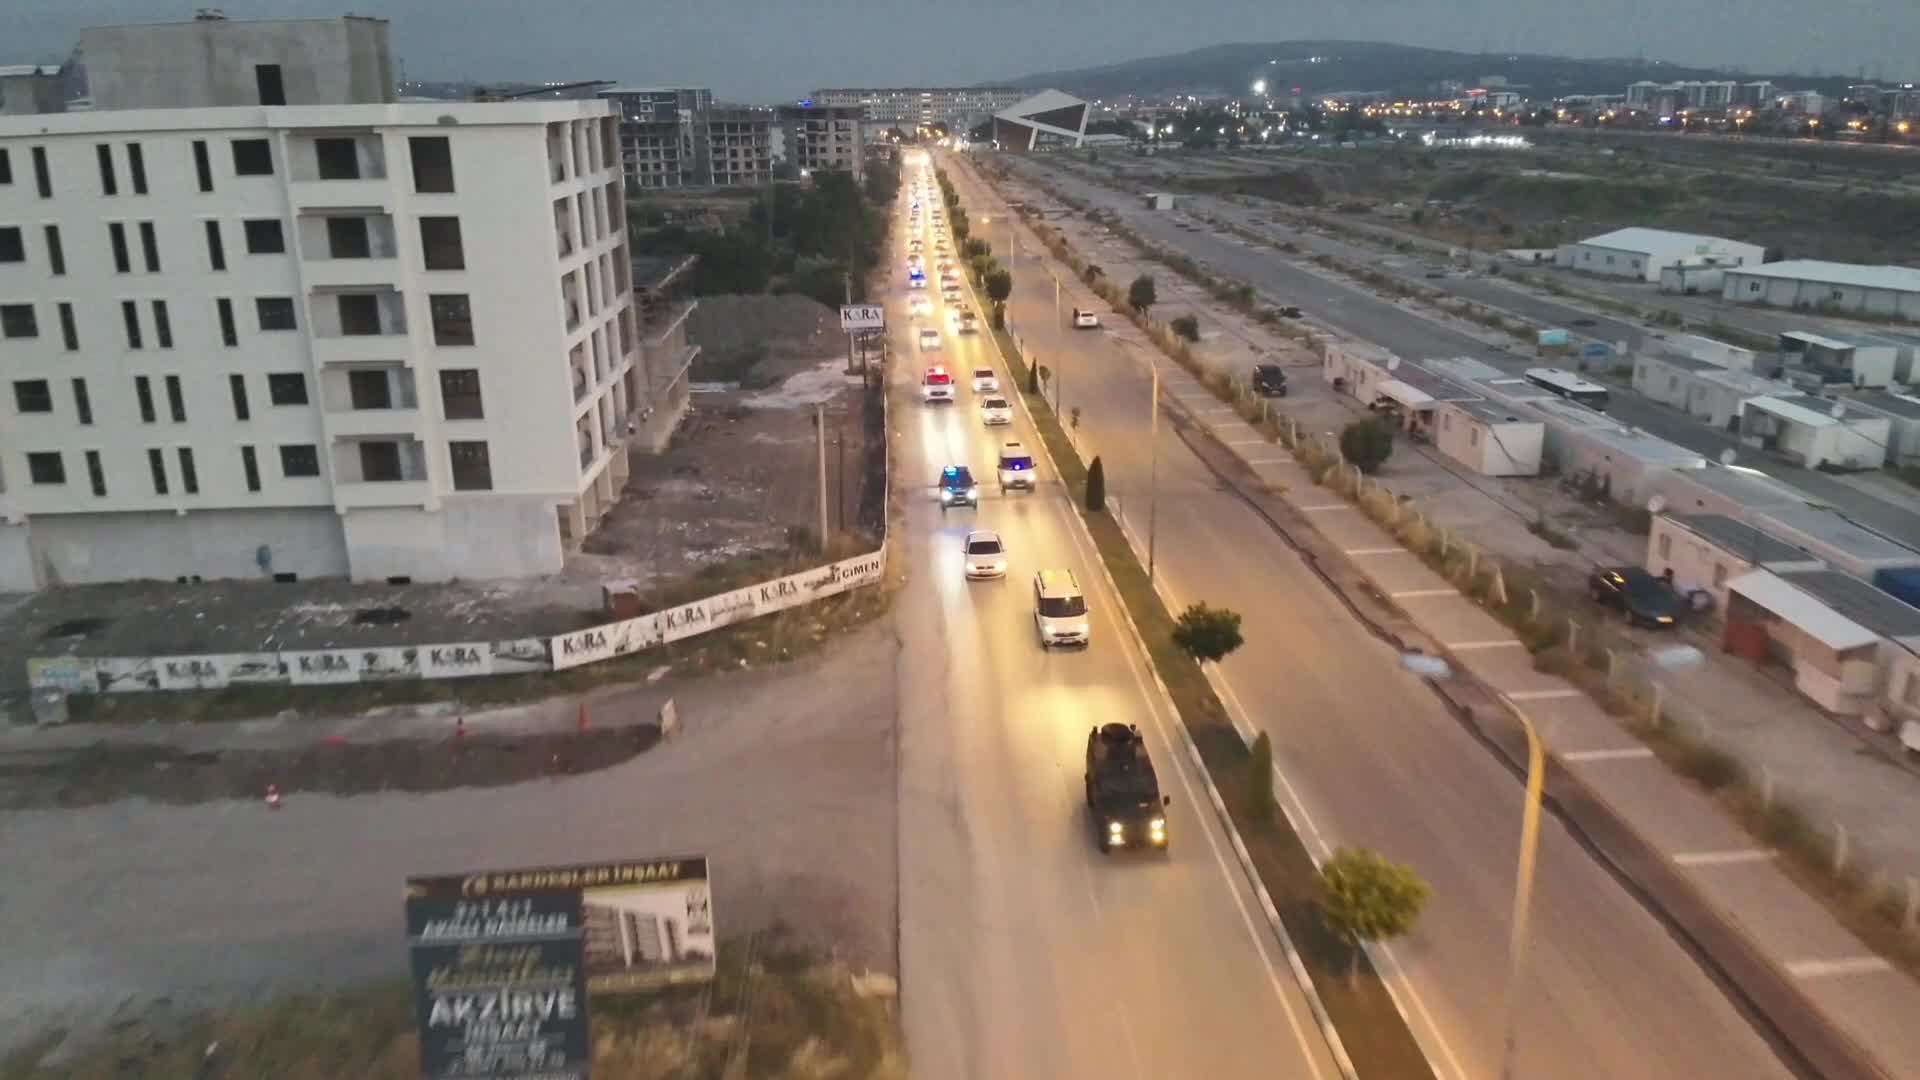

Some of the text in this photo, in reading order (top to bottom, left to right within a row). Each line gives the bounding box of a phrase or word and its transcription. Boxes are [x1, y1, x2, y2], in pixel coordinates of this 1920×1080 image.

[843, 308, 880, 321] KARA
[760, 579, 798, 602] KARA
[667, 606, 705, 629] KARA
[563, 631, 607, 655] KARA
[299, 654, 349, 672] KARA
[431, 647, 481, 664] KARA
[166, 661, 217, 678] KARA
